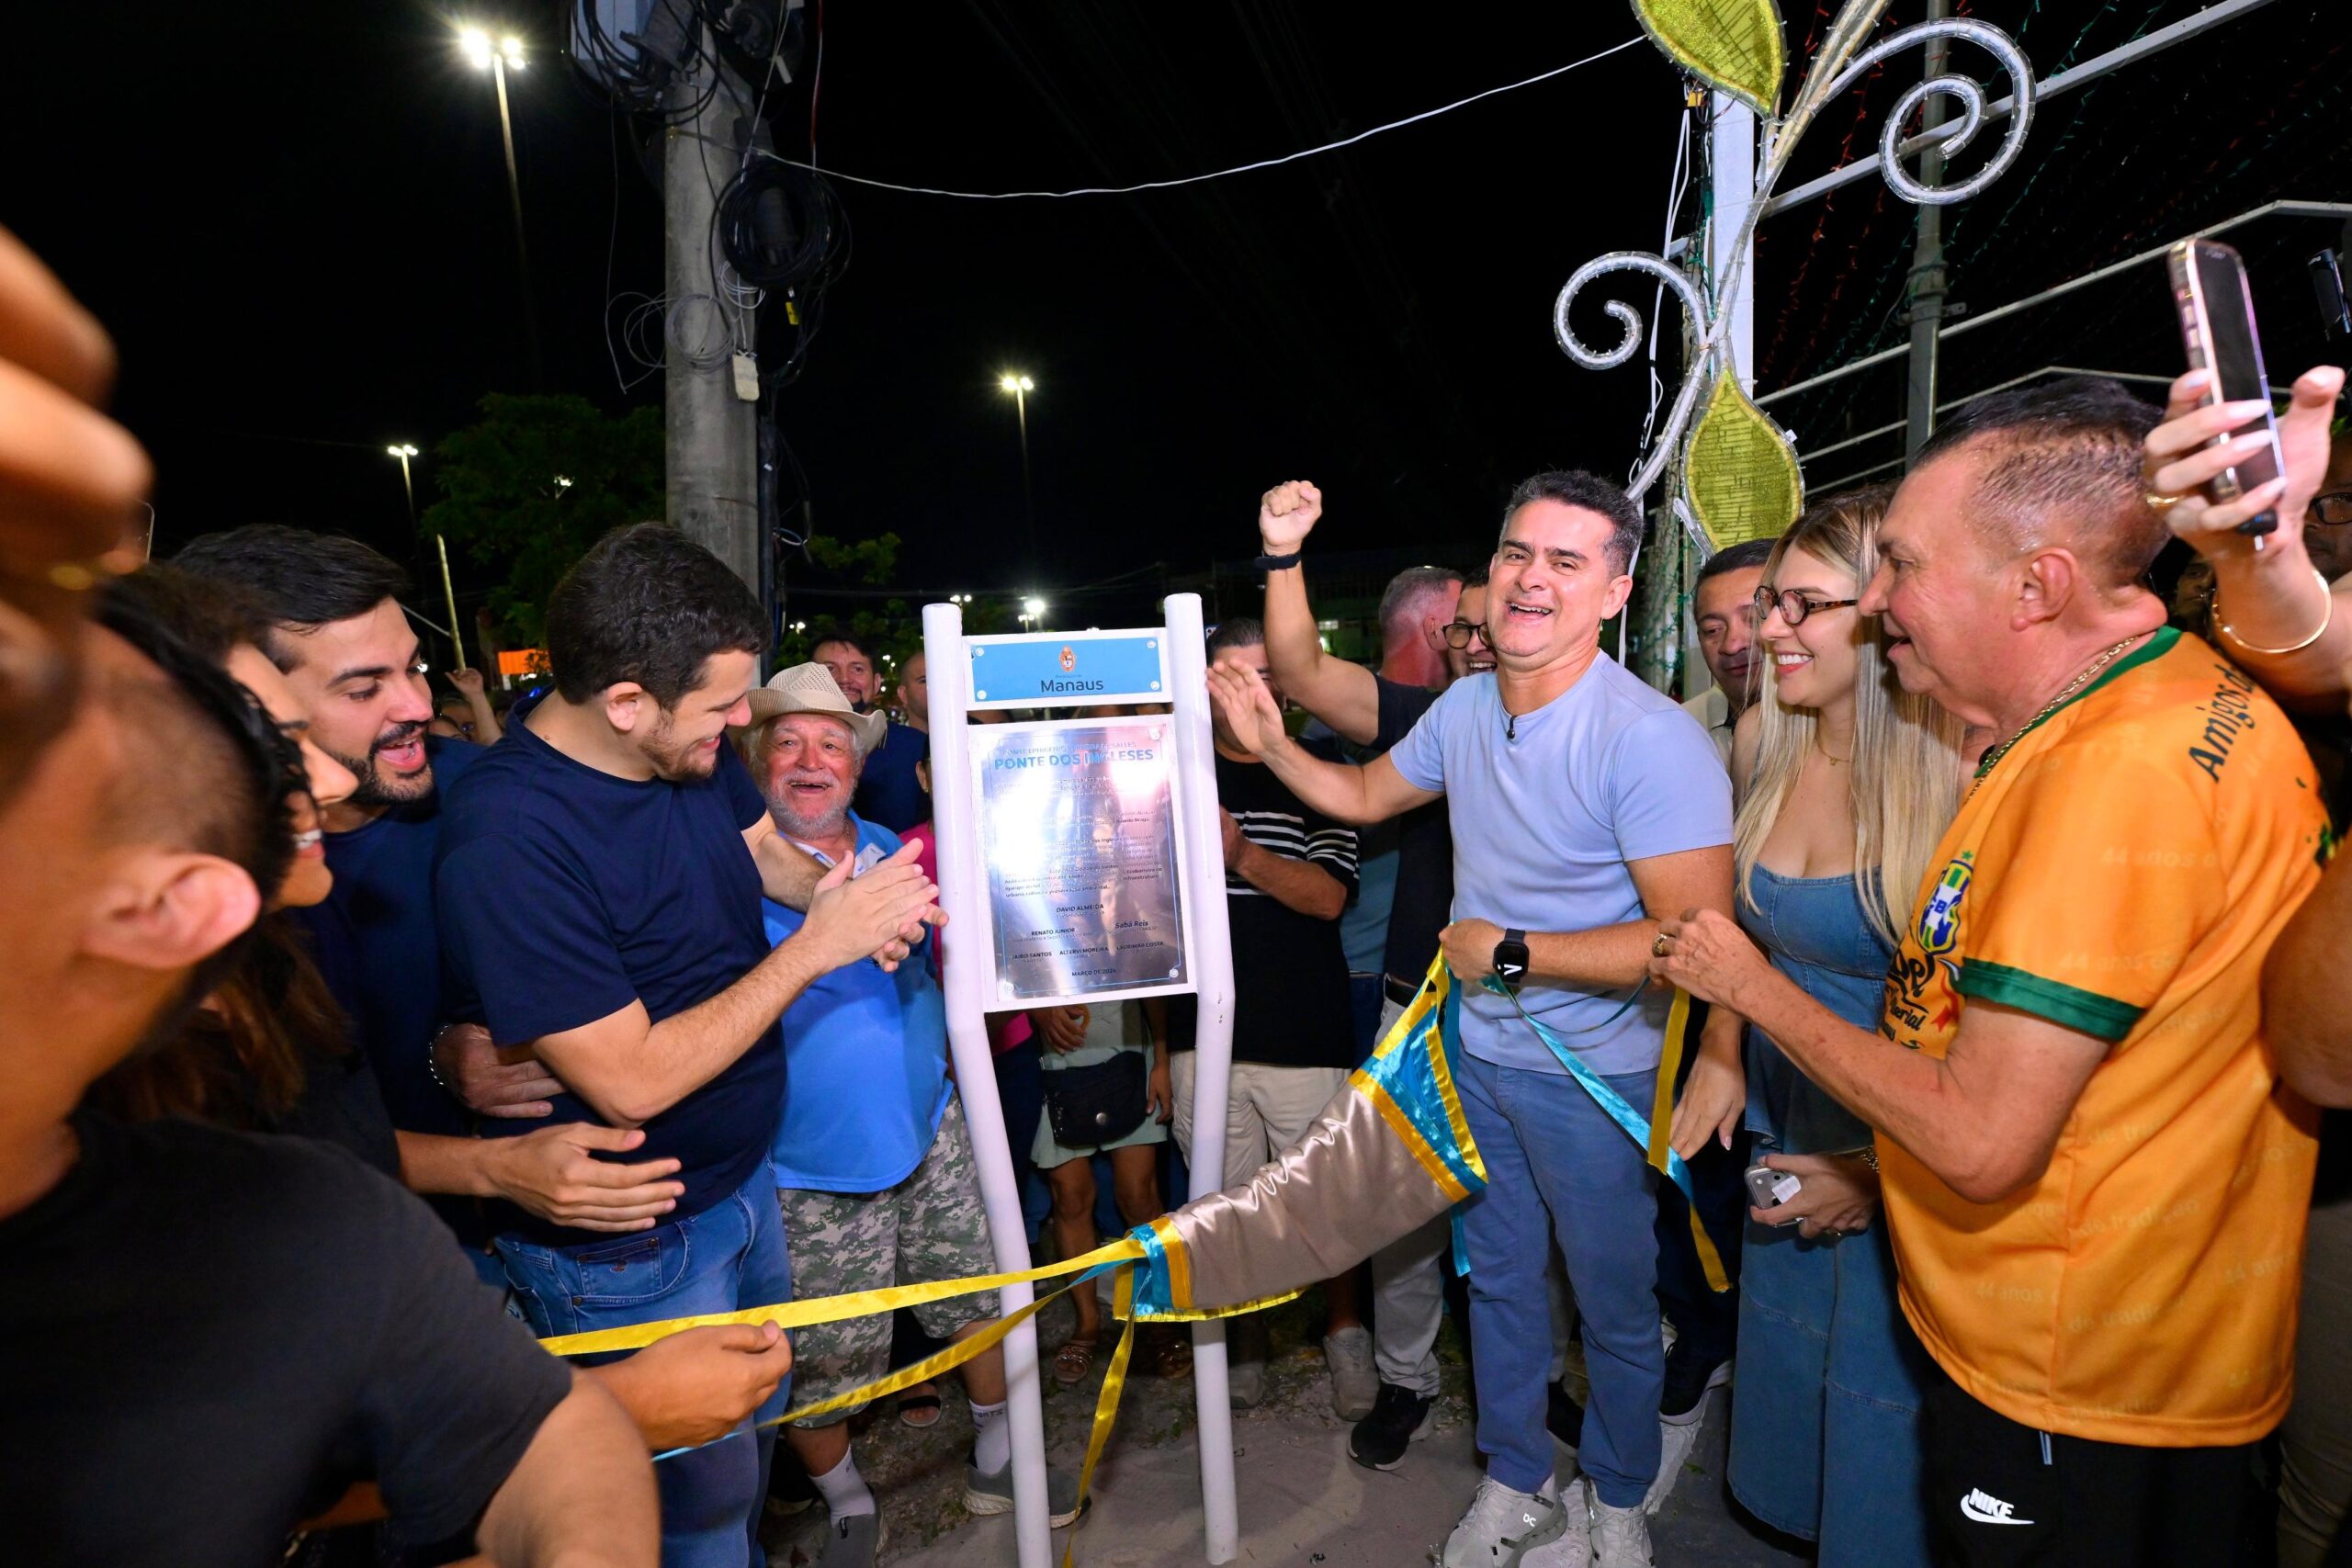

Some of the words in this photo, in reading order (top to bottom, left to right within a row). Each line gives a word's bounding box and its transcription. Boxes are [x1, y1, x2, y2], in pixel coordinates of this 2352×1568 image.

[1040, 679, 1104, 693] Manaus
[2188, 683, 2255, 784] Amigos
[994, 756, 1045, 771] PONTE
[1049, 753, 1081, 766] DOS
[1084, 749, 1154, 765] INGLESES
[1054, 927, 1076, 935] JUNIOR
[1115, 920, 1133, 929] Sabá
[1071, 969, 1092, 977] MARÇO
[1968, 1487, 2015, 1519] NIKE
